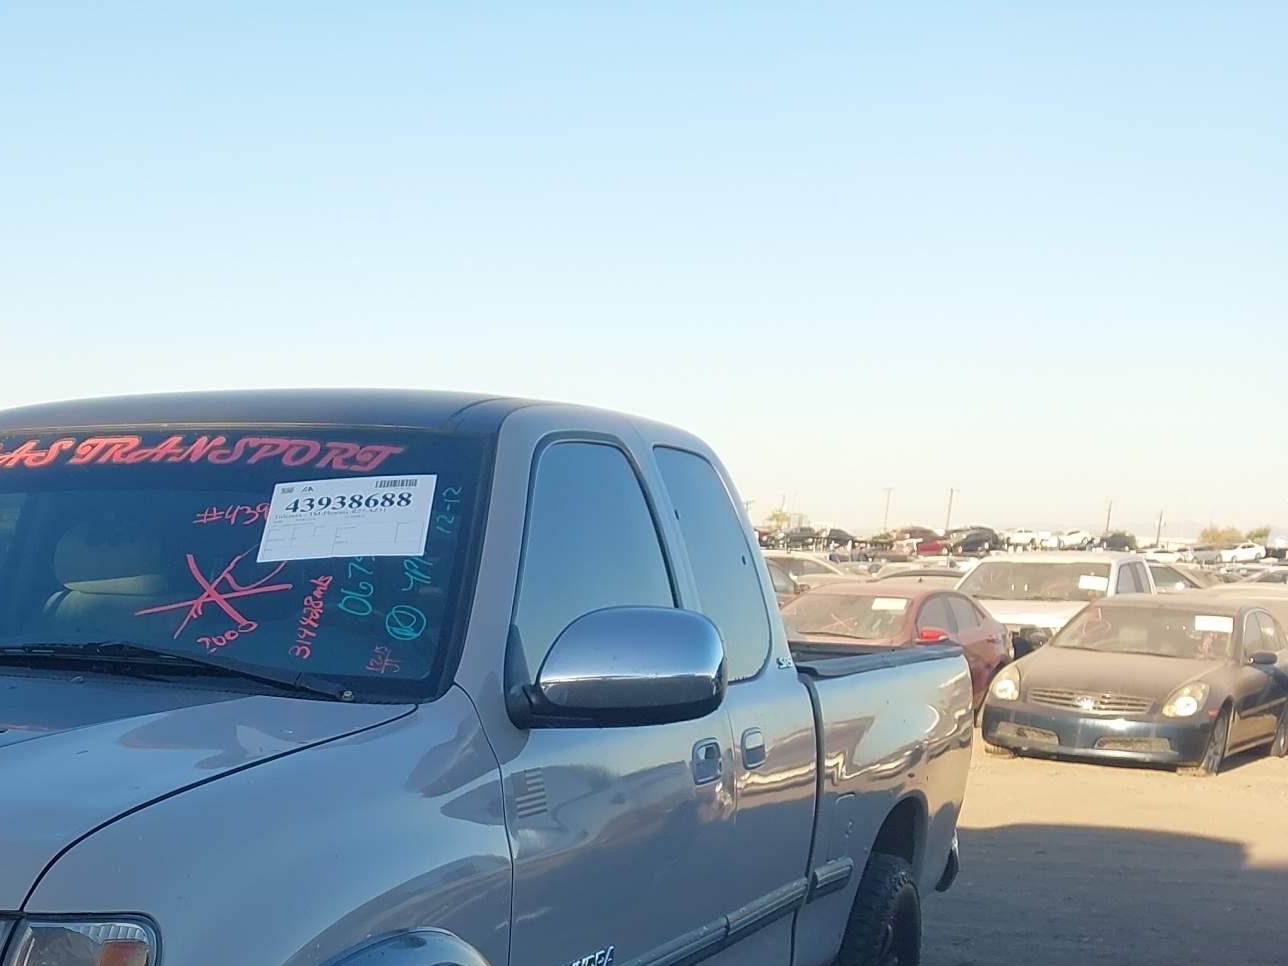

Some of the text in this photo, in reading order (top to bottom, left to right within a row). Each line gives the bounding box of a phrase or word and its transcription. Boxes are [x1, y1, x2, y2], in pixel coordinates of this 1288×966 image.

[65, 434, 405, 473] TRANSPORT
[285, 492, 413, 513] 43938688
[436, 486, 462, 534] 12-12
